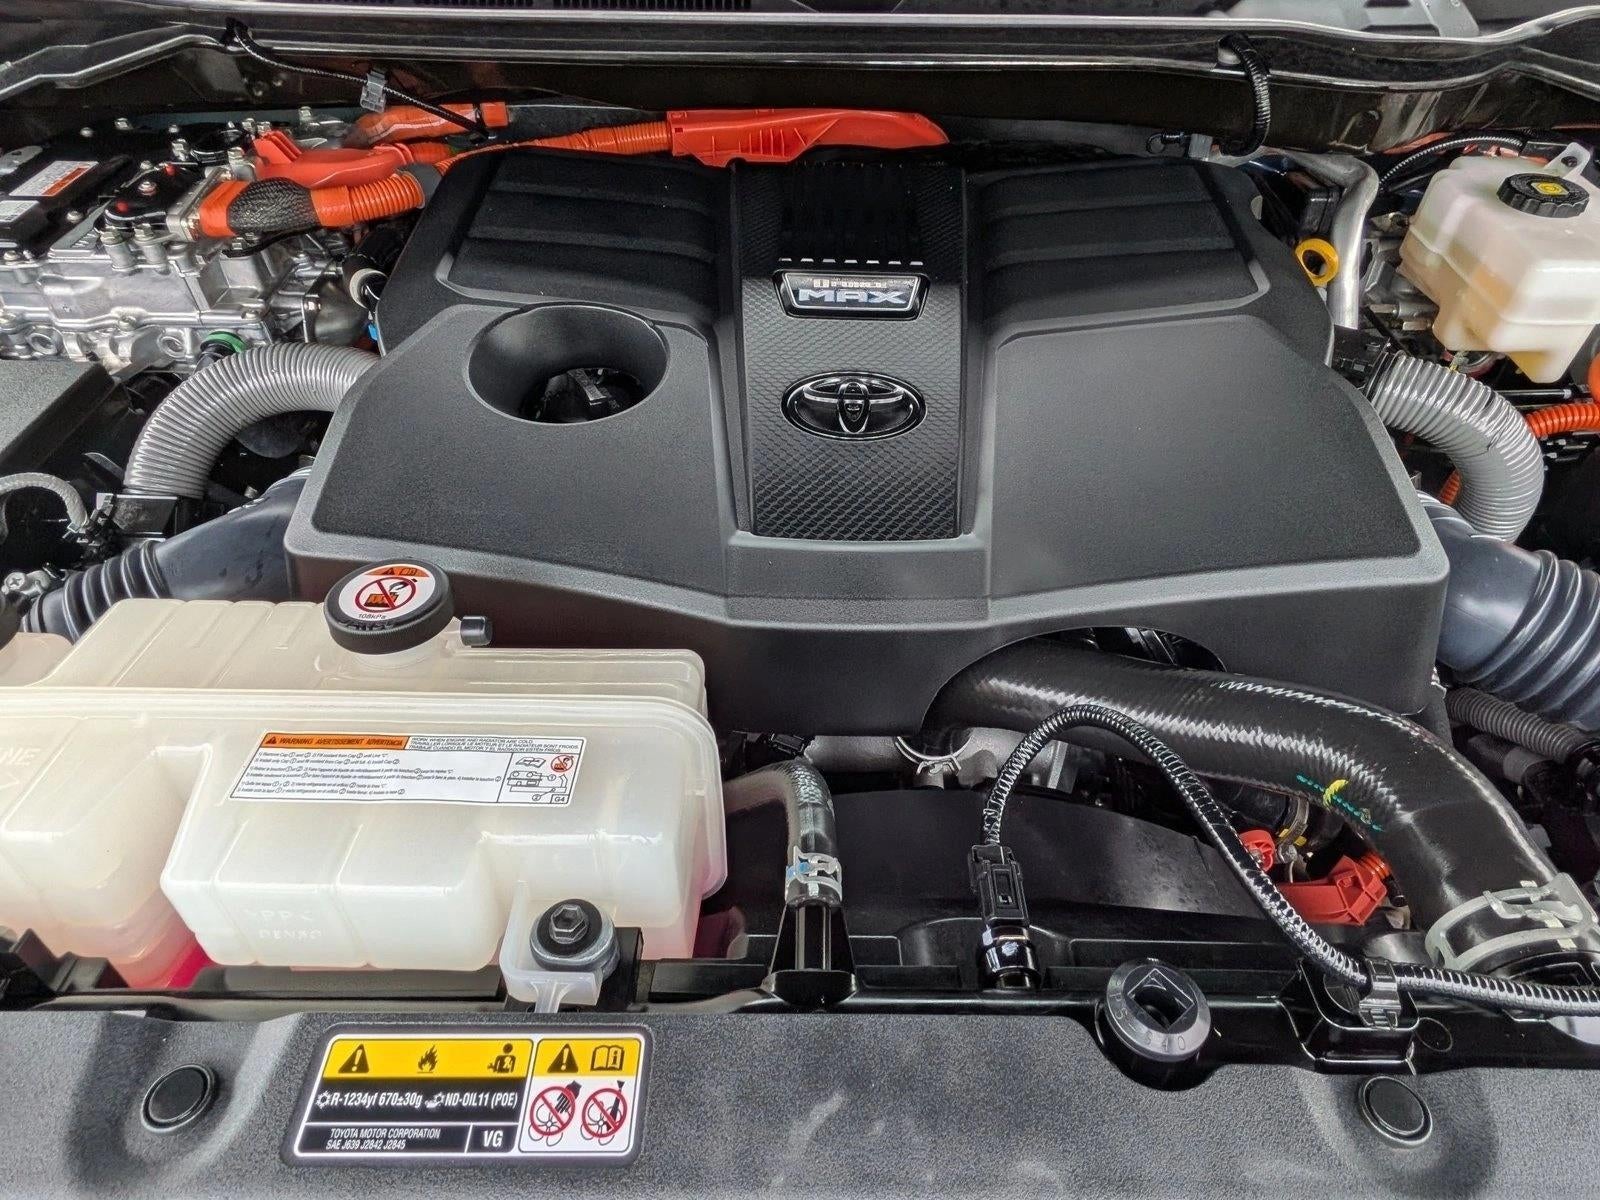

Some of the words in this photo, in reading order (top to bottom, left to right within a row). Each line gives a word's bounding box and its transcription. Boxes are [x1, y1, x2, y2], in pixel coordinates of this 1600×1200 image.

[798, 288, 907, 304] MAX
[279, 737, 313, 745] WARNING
[554, 795, 566, 803] G4
[330, 1092, 378, 1109] R-1234yf
[378, 1092, 423, 1109] 670±30g
[490, 1092, 518, 1109] (POE)
[330, 1128, 359, 1138] TOYOTA
[359, 1128, 387, 1139] MOTOR
[387, 1128, 441, 1139] CORPORATION
[482, 1130, 504, 1147] VG
[326, 1139, 342, 1150] SAE
[341, 1140, 361, 1150] J639
[360, 1140, 384, 1150] J2842
[383, 1140, 407, 1150] J2845
